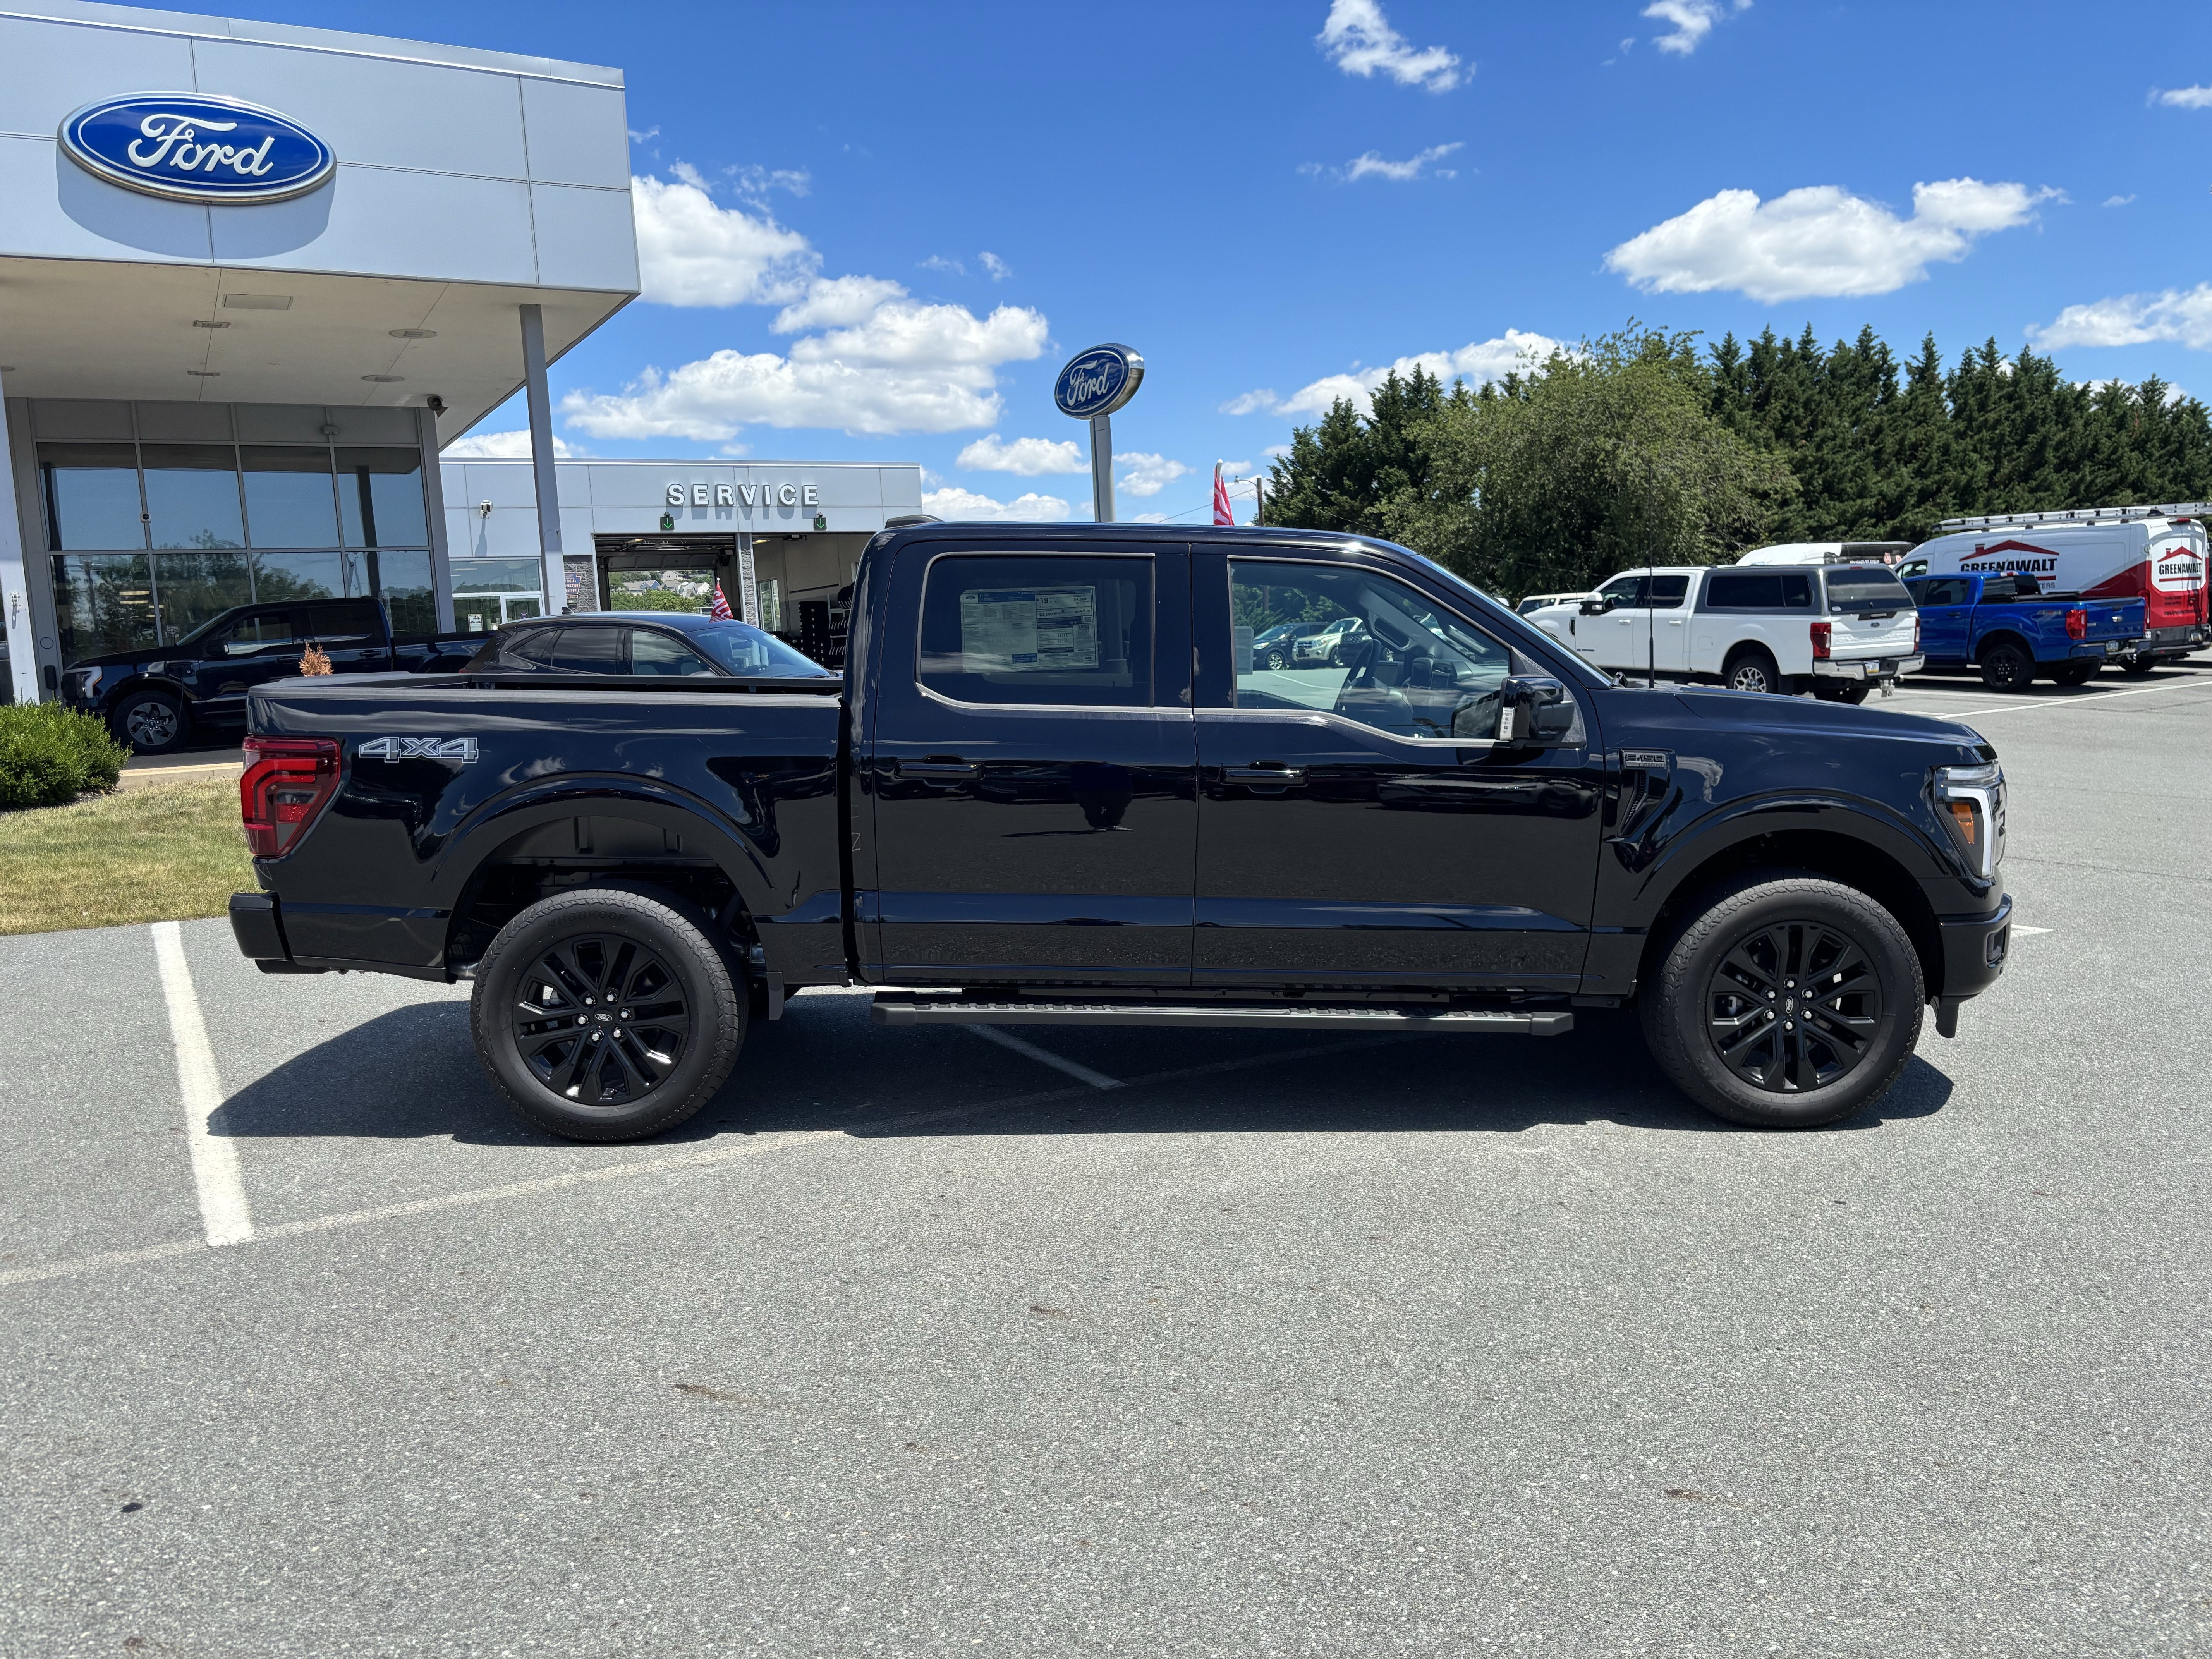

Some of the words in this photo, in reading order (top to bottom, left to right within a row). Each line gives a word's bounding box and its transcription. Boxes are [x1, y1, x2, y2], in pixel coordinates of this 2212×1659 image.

[128, 113, 274, 176] Ford
[1066, 360, 1109, 406] Ford
[667, 483, 819, 507] SERVICE
[2159, 563, 2202, 575] GREENAWALT
[359, 737, 478, 763] 4X4
